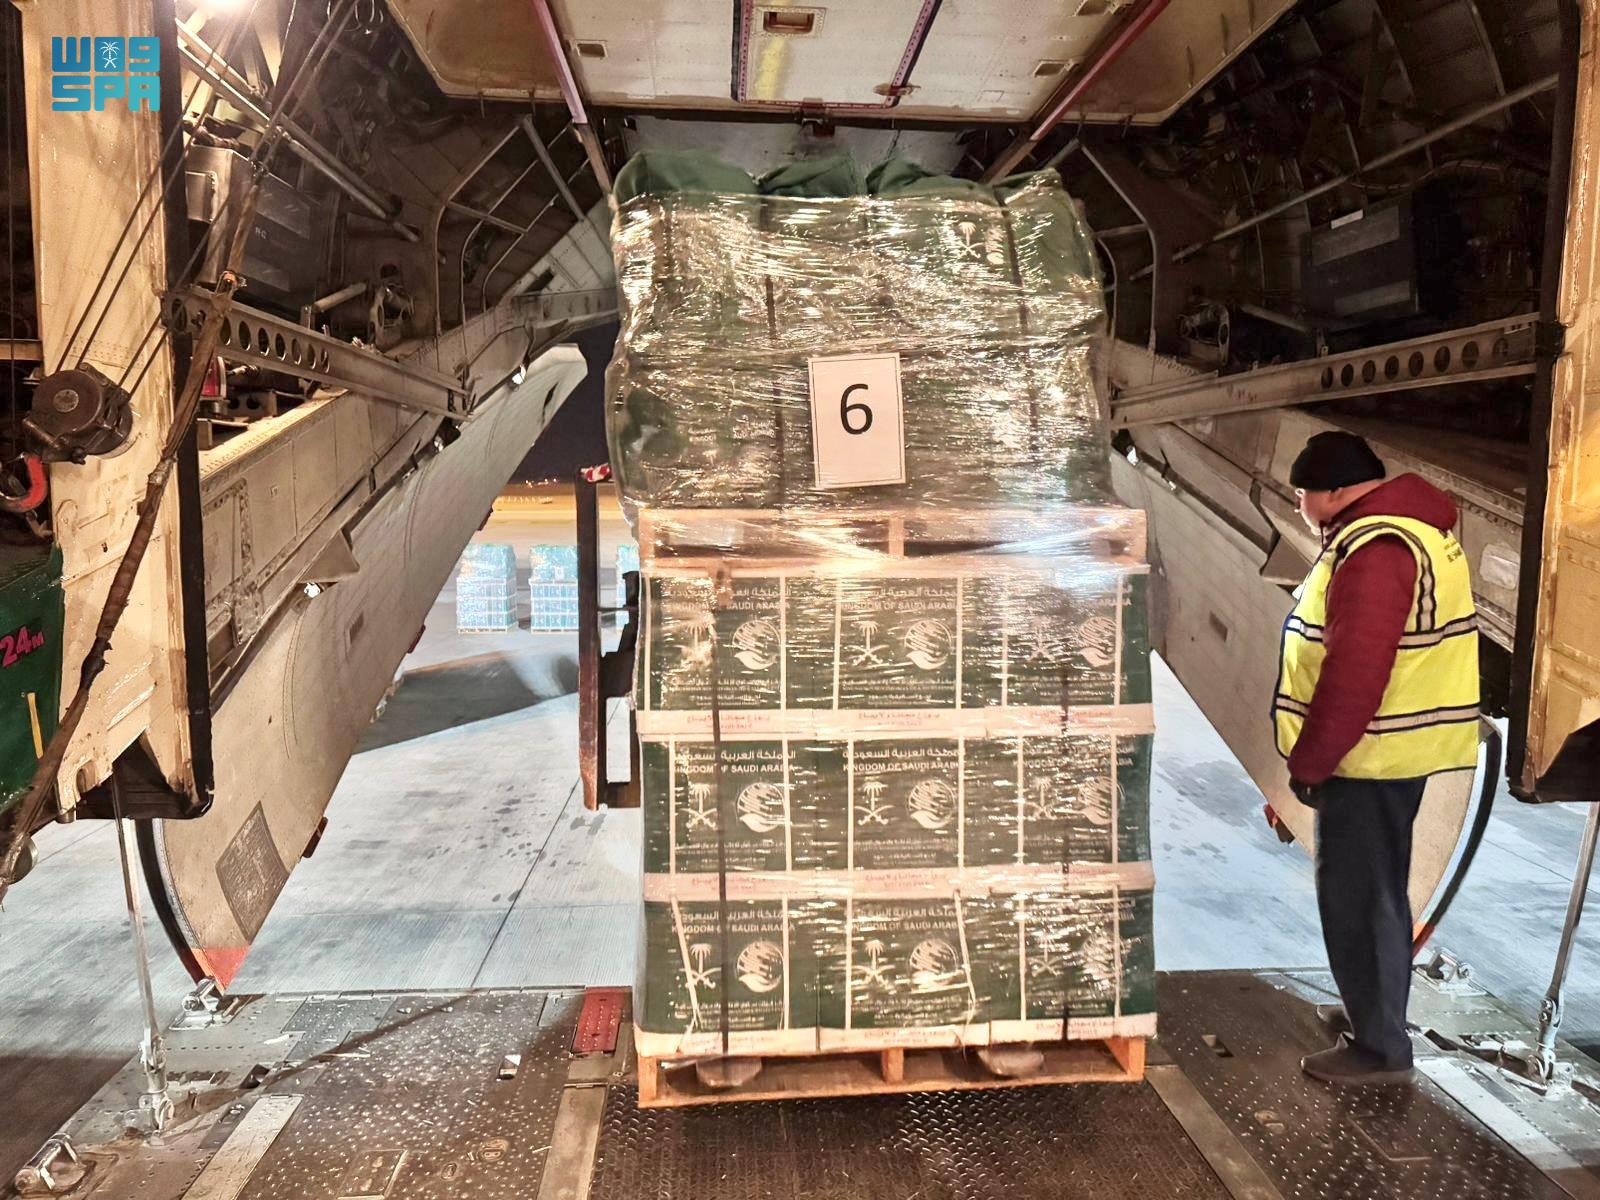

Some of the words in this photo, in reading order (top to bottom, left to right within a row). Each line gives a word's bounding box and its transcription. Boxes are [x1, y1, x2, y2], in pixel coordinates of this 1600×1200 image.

[840, 383, 873, 435] 6
[757, 601, 791, 610] ARABA
[927, 600, 959, 609] ARABI
[721, 750, 755, 762] العربية
[843, 749, 890, 760] السعودة
[891, 748, 926, 759] العربية
[676, 765, 714, 774] INGDOM
[731, 764, 759, 773] SAUDI
[760, 764, 796, 772] ARAA
[843, 762, 886, 771] KNGDOM
[901, 761, 929, 770] SAUDI
[931, 760, 965, 769] ARABI
[671, 925, 715, 934] KNGDOM
[731, 924, 759, 933] SAUDI
[760, 923, 796, 932] ARAA
[903, 920, 931, 929] SAUDI
[931, 920, 966, 929] ARAB
